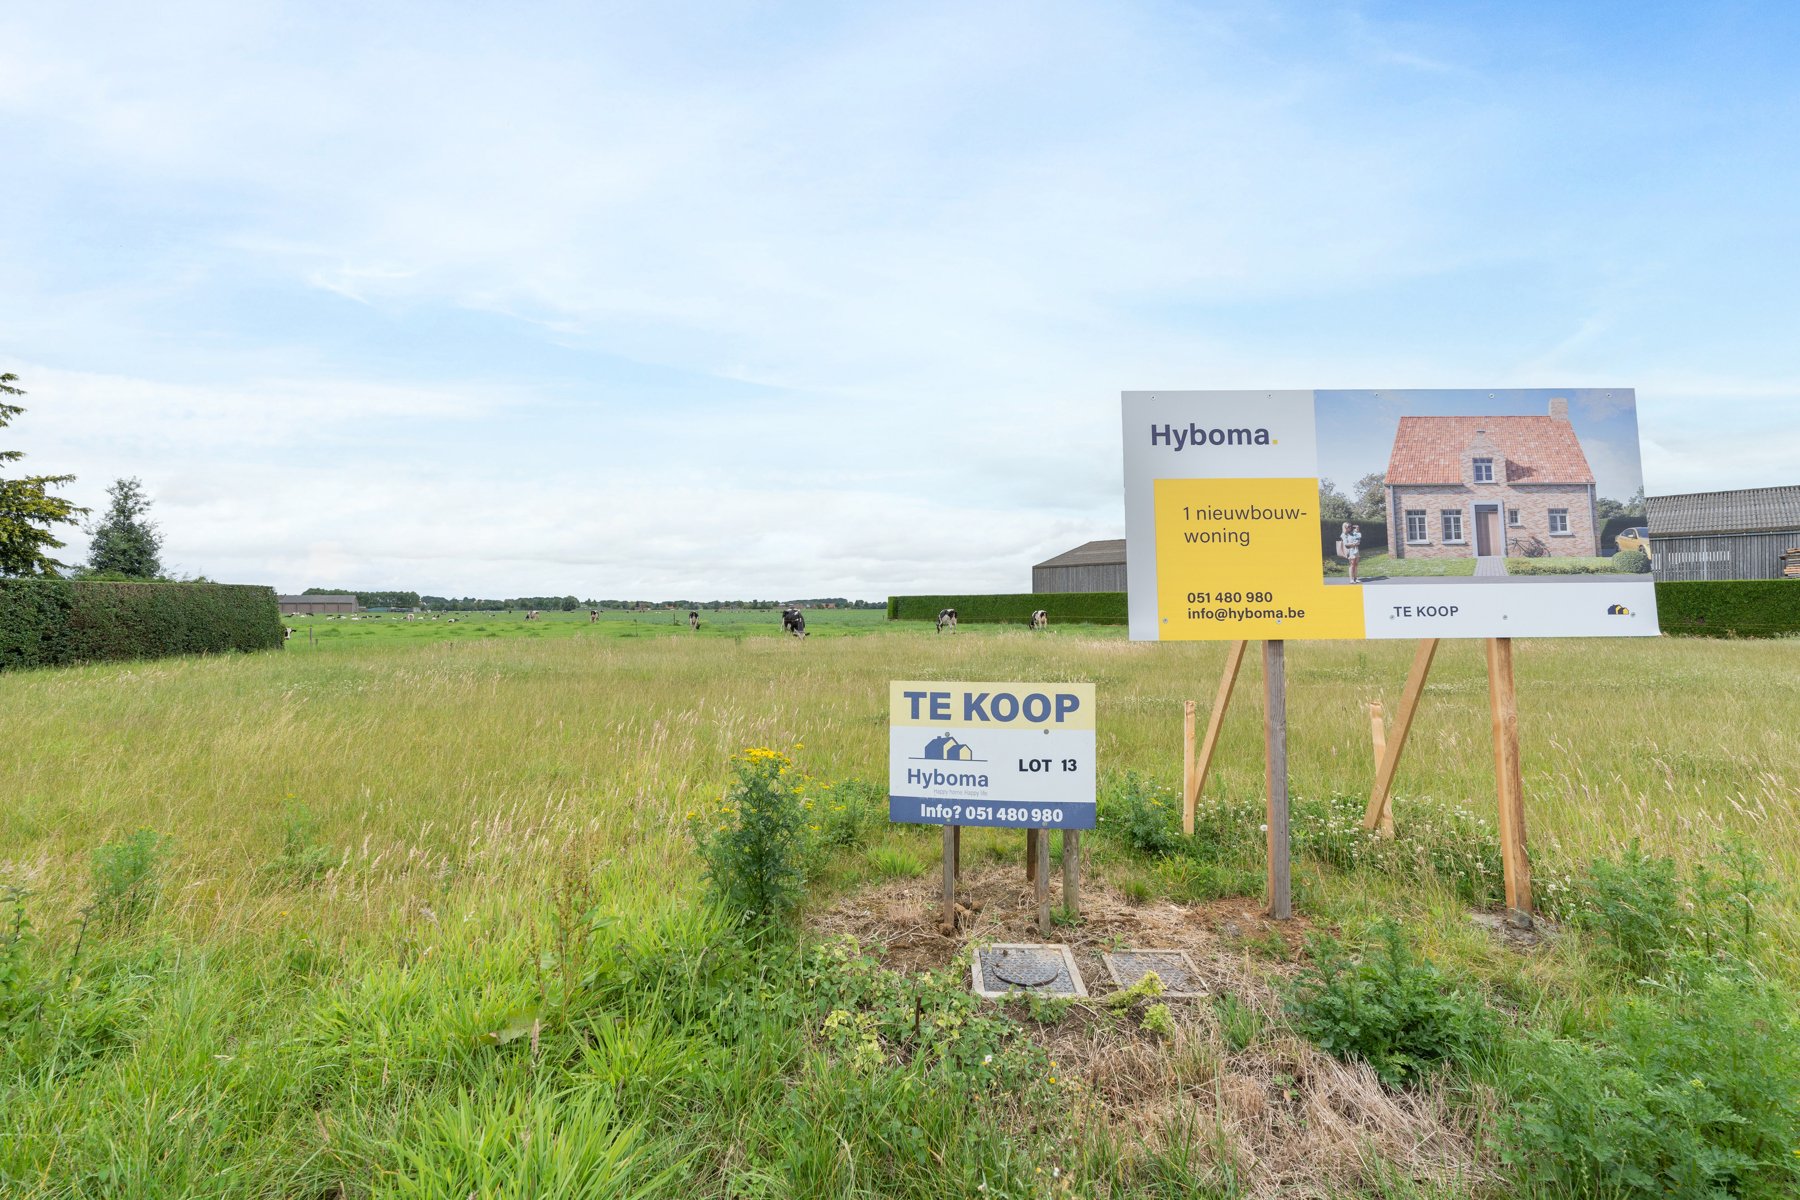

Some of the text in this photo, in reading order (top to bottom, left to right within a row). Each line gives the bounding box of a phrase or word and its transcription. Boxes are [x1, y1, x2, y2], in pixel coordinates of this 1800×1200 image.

[1151, 423, 1278, 452] Hyboma.
[1182, 505, 1307, 521] 1 nieuwbouw-
[1184, 528, 1250, 547] woning
[1187, 591, 1273, 604] 051 480 980
[1188, 607, 1305, 622] info@hyboma.be
[1393, 605, 1459, 617] TE KOOP
[903, 691, 1080, 723] TE KOOP
[1018, 758, 1077, 773] LOT 13
[907, 768, 989, 789] Hyboma
[933, 788, 948, 796] Happy
[964, 789, 979, 797] Happy
[920, 803, 1063, 823] Info? 051 480 980
